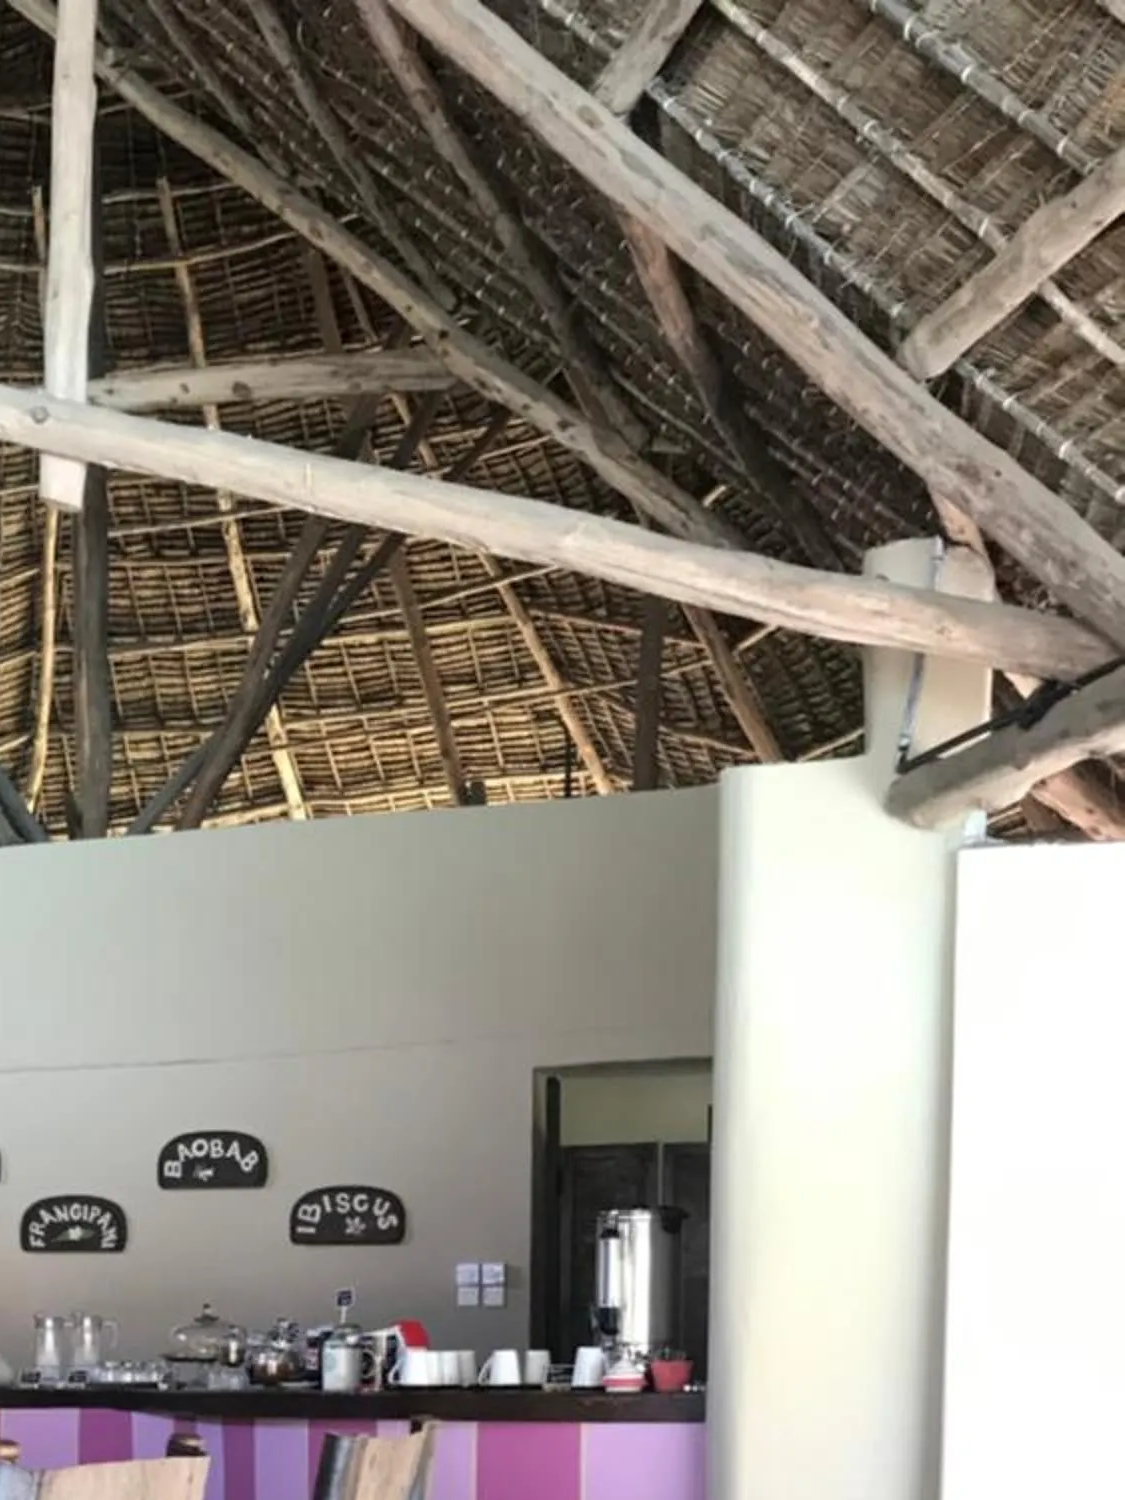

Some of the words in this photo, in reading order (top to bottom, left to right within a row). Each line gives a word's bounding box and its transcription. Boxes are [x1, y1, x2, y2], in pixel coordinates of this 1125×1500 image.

[164, 1138, 260, 1179] BAOBAB
[28, 1202, 118, 1248] FRANGIPANI
[296, 1192, 398, 1235] IBISCUS
